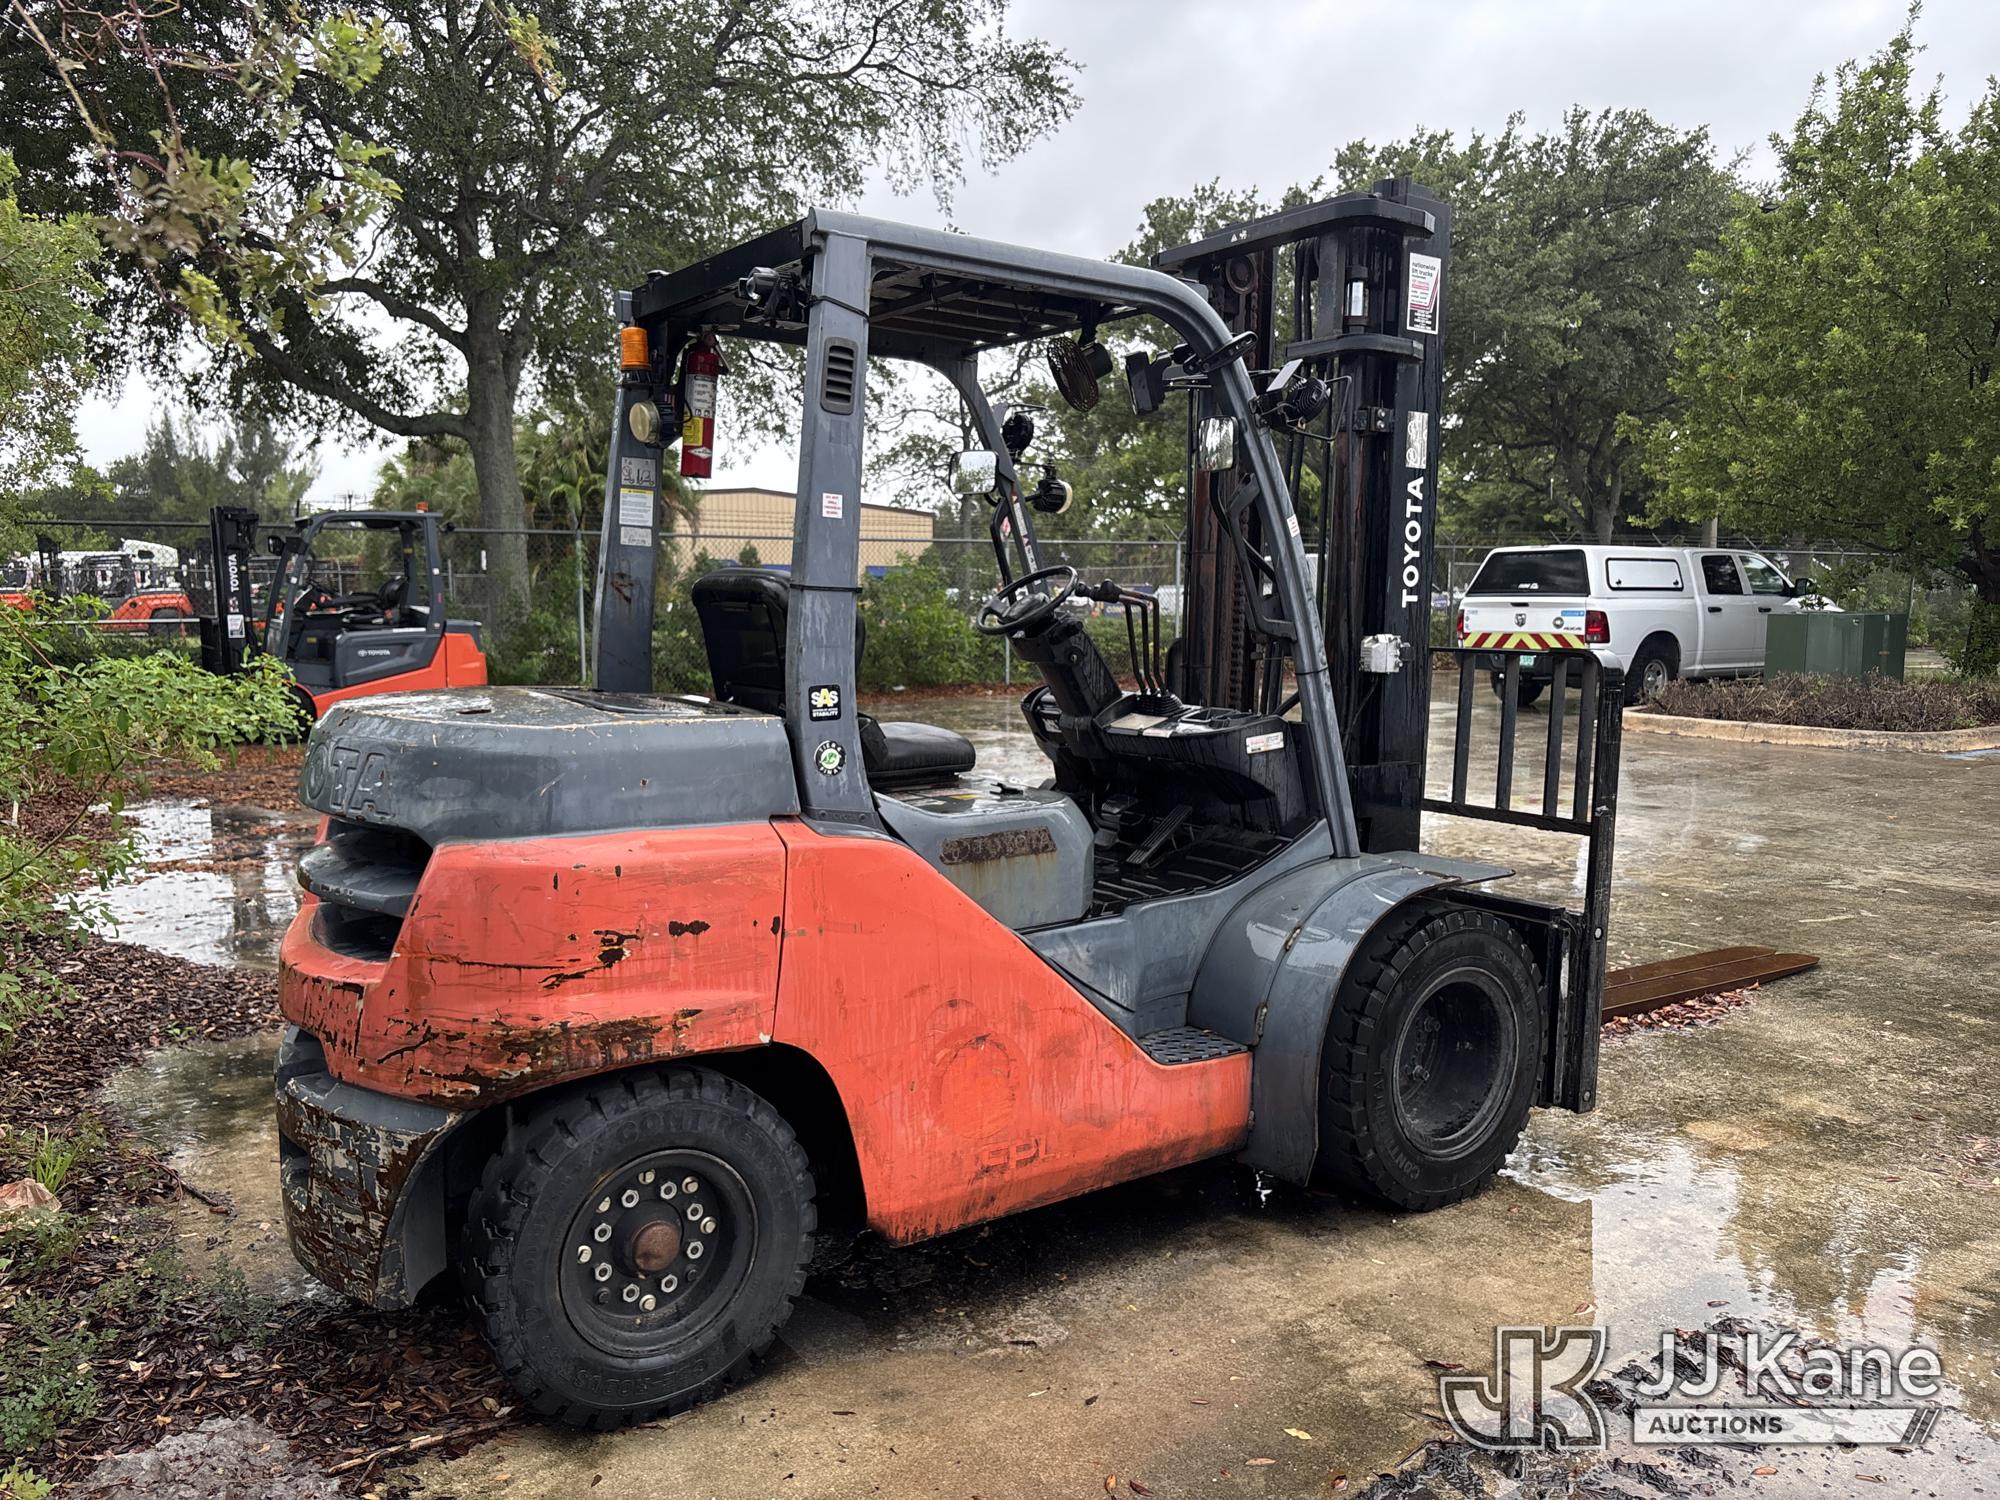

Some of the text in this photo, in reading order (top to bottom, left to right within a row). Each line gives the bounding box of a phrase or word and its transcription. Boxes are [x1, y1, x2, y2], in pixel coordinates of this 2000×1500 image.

[1401, 476, 1424, 609] TOYOTA
[228, 553, 240, 593] TOYOTA
[367, 648, 391, 657] TOYOTA
[811, 687, 839, 708] SAS
[819, 765, 842, 775] FINAL
